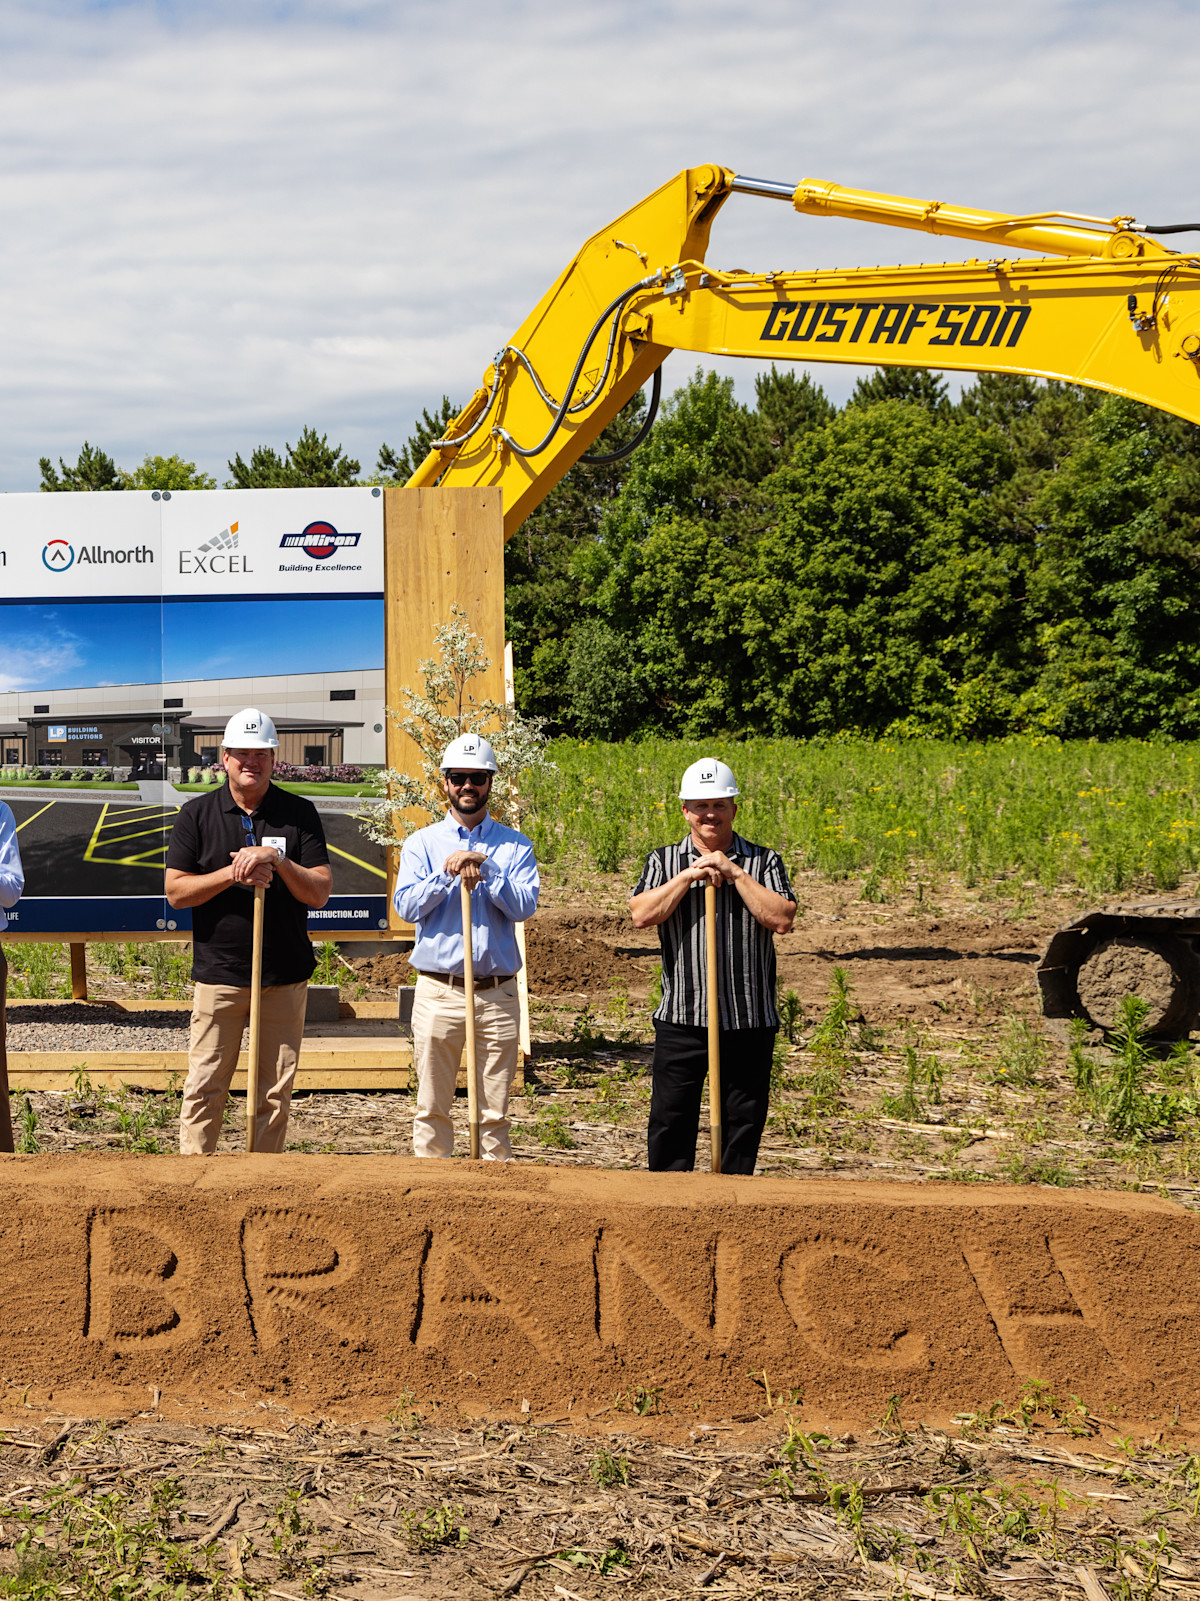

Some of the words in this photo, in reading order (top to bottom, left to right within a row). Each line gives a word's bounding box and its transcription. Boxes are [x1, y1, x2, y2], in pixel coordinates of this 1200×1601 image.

[759, 301, 1032, 347] GUSTAFSON
[303, 534, 357, 547] Miron
[77, 545, 154, 564] Allnorth
[179, 550, 254, 574] EXCEL
[278, 564, 313, 573] Building
[315, 563, 362, 571] Excellence
[49, 727, 65, 738] LP
[463, 745, 475, 753] LP
[7, 912, 19, 920] LIFE
[82, 1205, 1142, 1378] BRANCH
